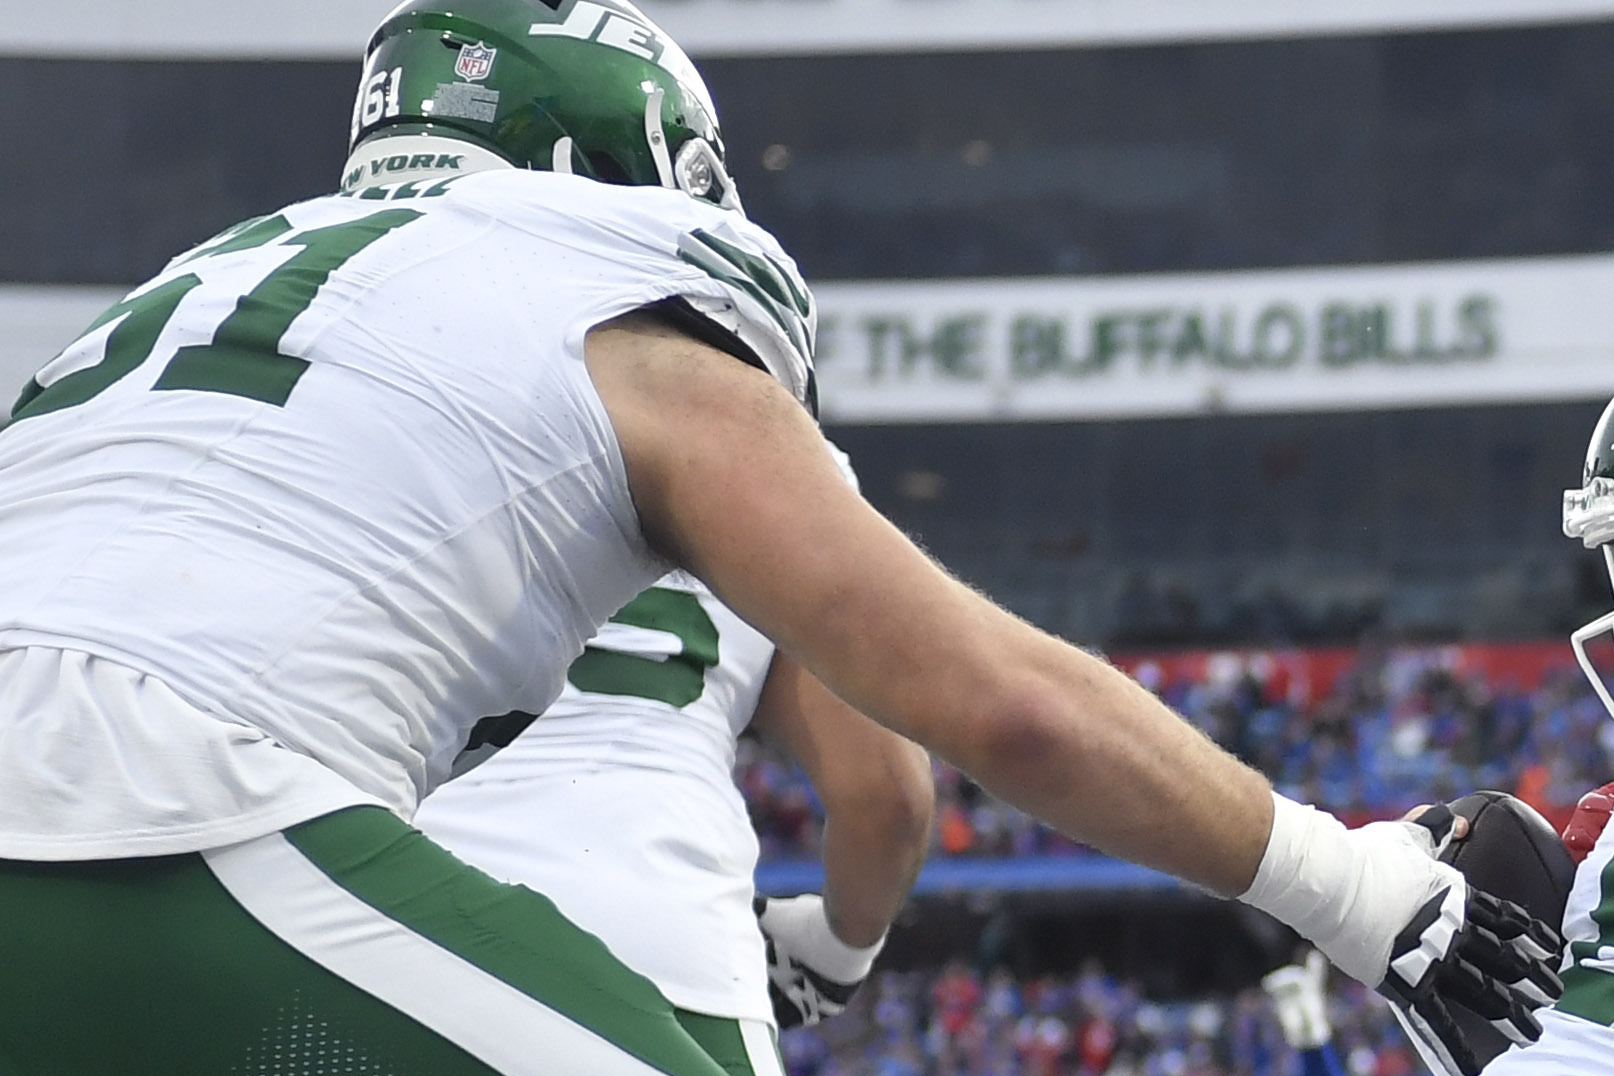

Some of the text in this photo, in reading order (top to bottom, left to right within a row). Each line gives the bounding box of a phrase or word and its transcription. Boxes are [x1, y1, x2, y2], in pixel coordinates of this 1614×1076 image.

[461, 58, 485, 75] NFL
[362, 67, 402, 126] 61
[371, 154, 464, 175] YORK
[862, 313, 987, 384] THE
[1010, 302, 1299, 380] BUFFALO
[1321, 293, 1501, 369] BILLS
